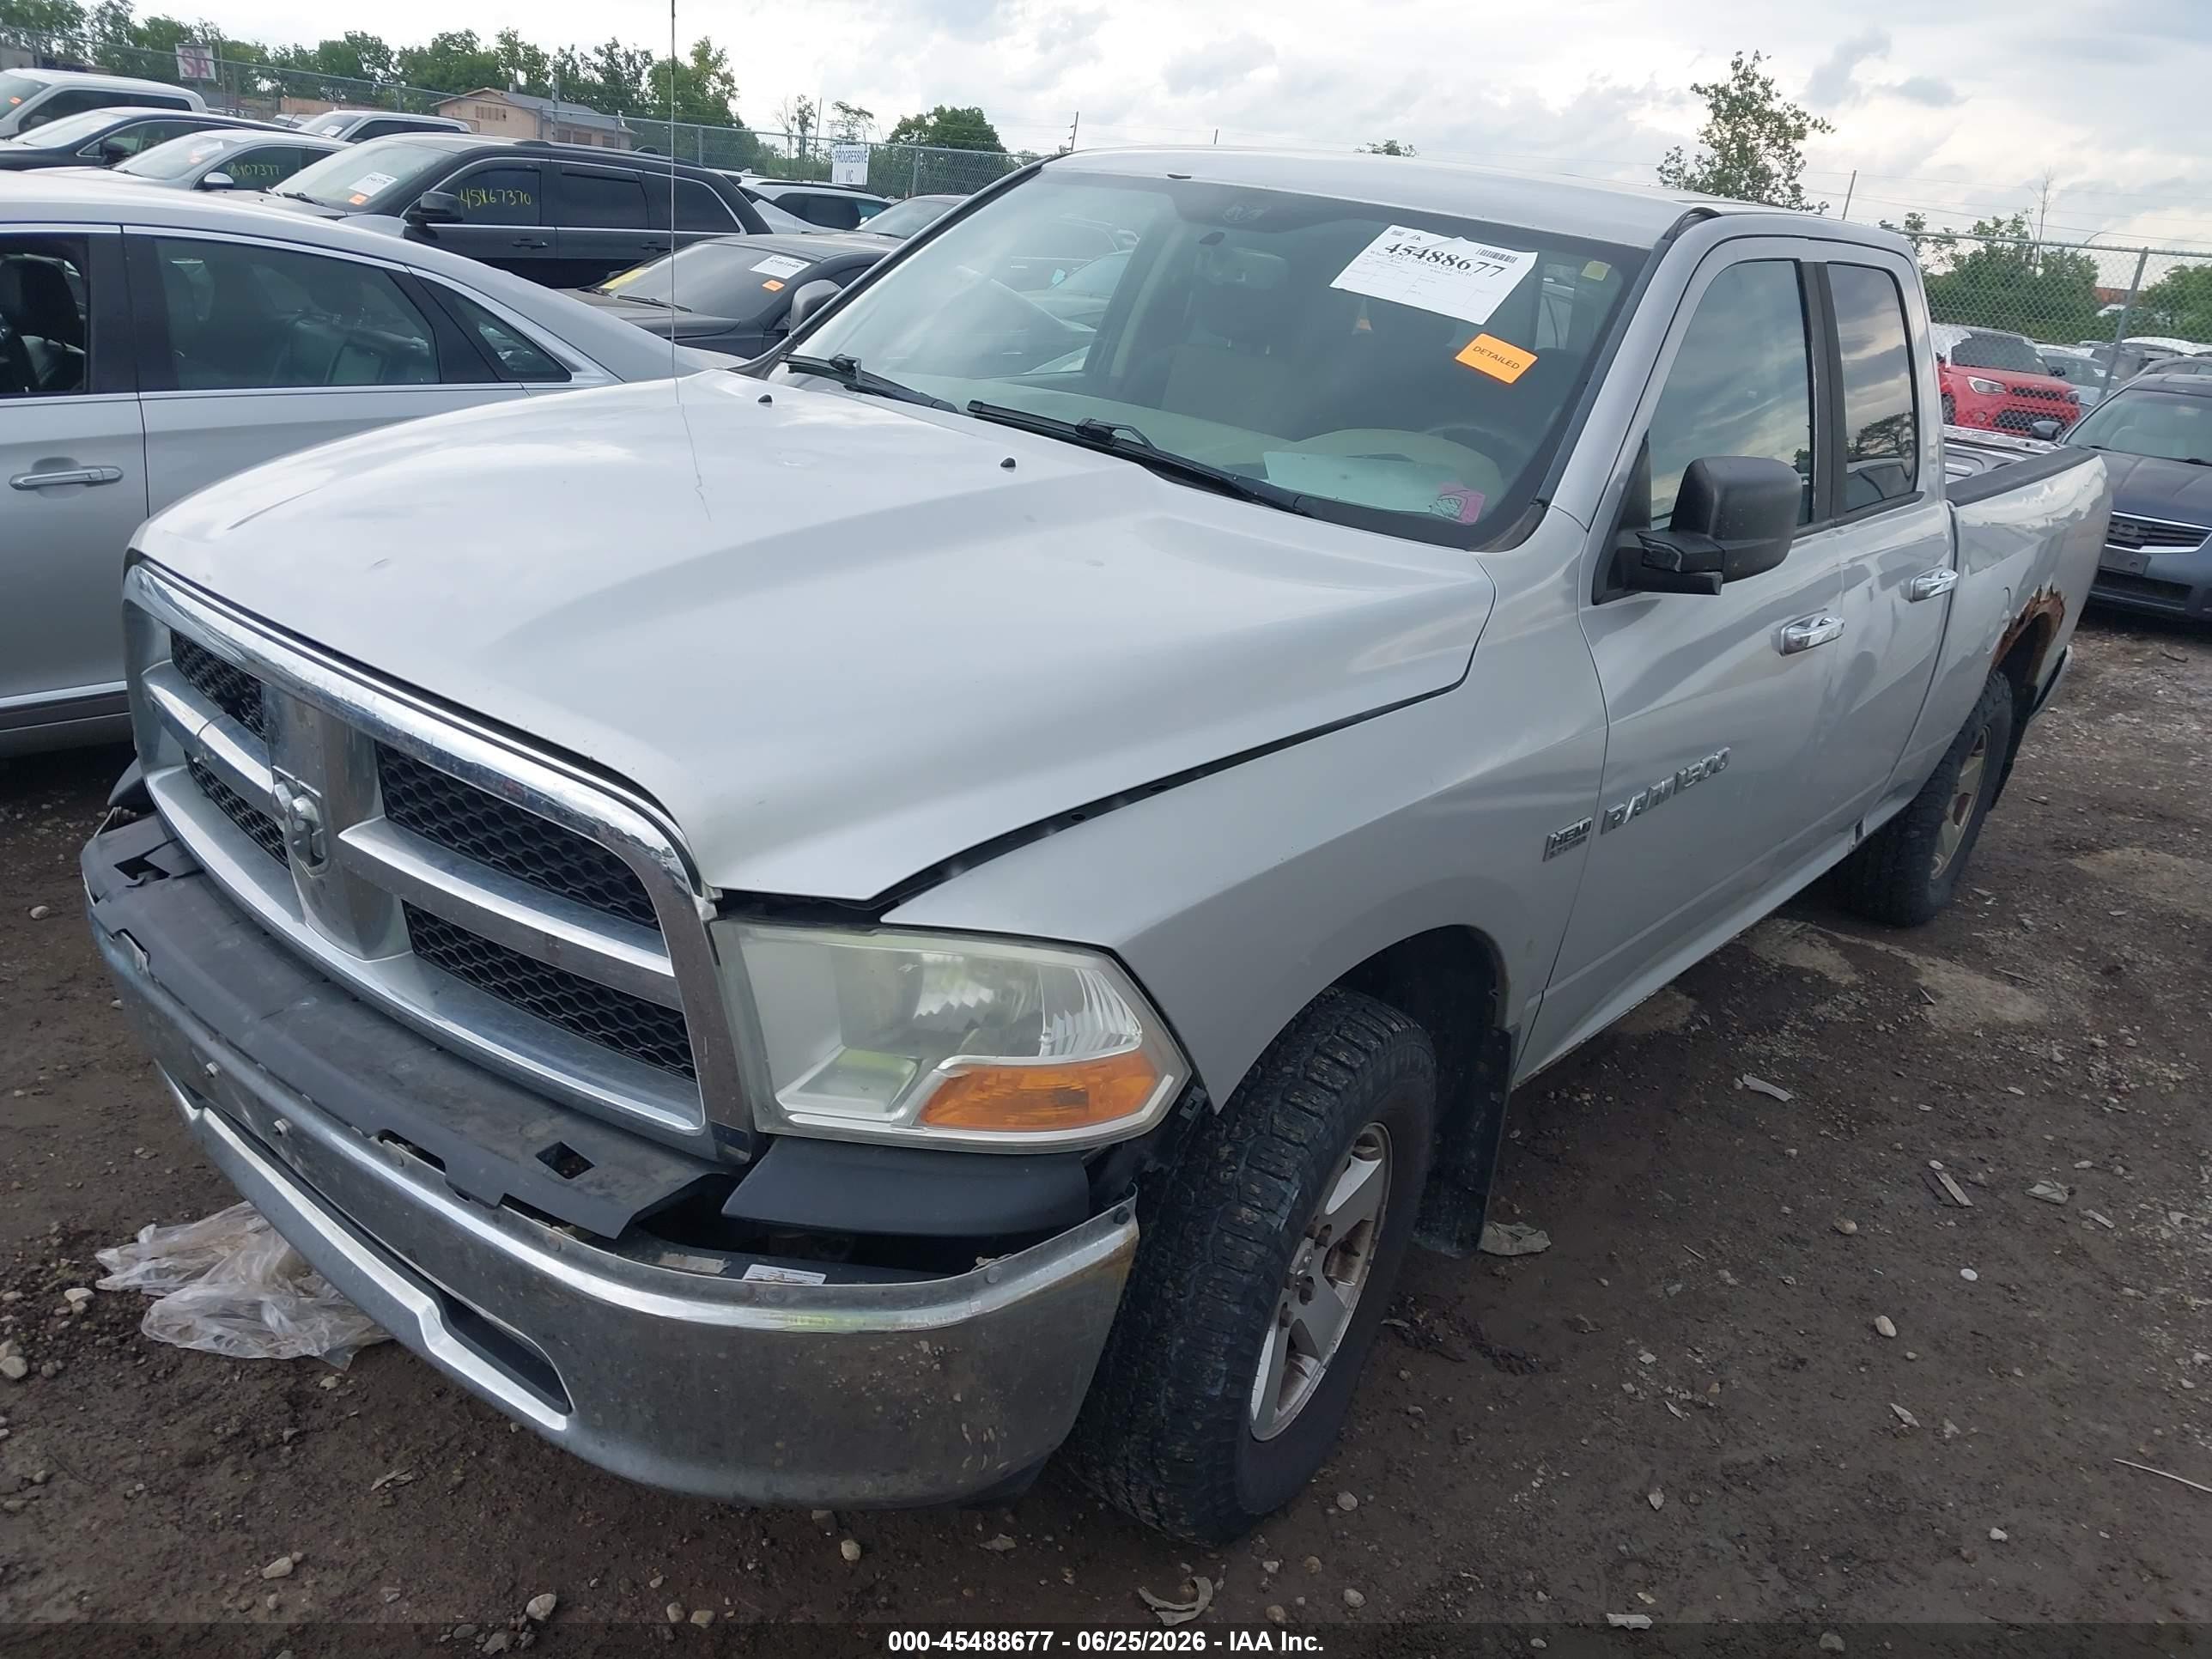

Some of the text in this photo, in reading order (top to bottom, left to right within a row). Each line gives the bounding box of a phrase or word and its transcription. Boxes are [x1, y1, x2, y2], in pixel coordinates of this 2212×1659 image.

[835, 149, 867, 163] PROGRESSIVE
[1385, 242, 1507, 277] 45488677
[1473, 345, 1520, 369] DETAILED
[1601, 746, 1731, 836] RAM 1500
[1544, 816, 1593, 852] HEMI
